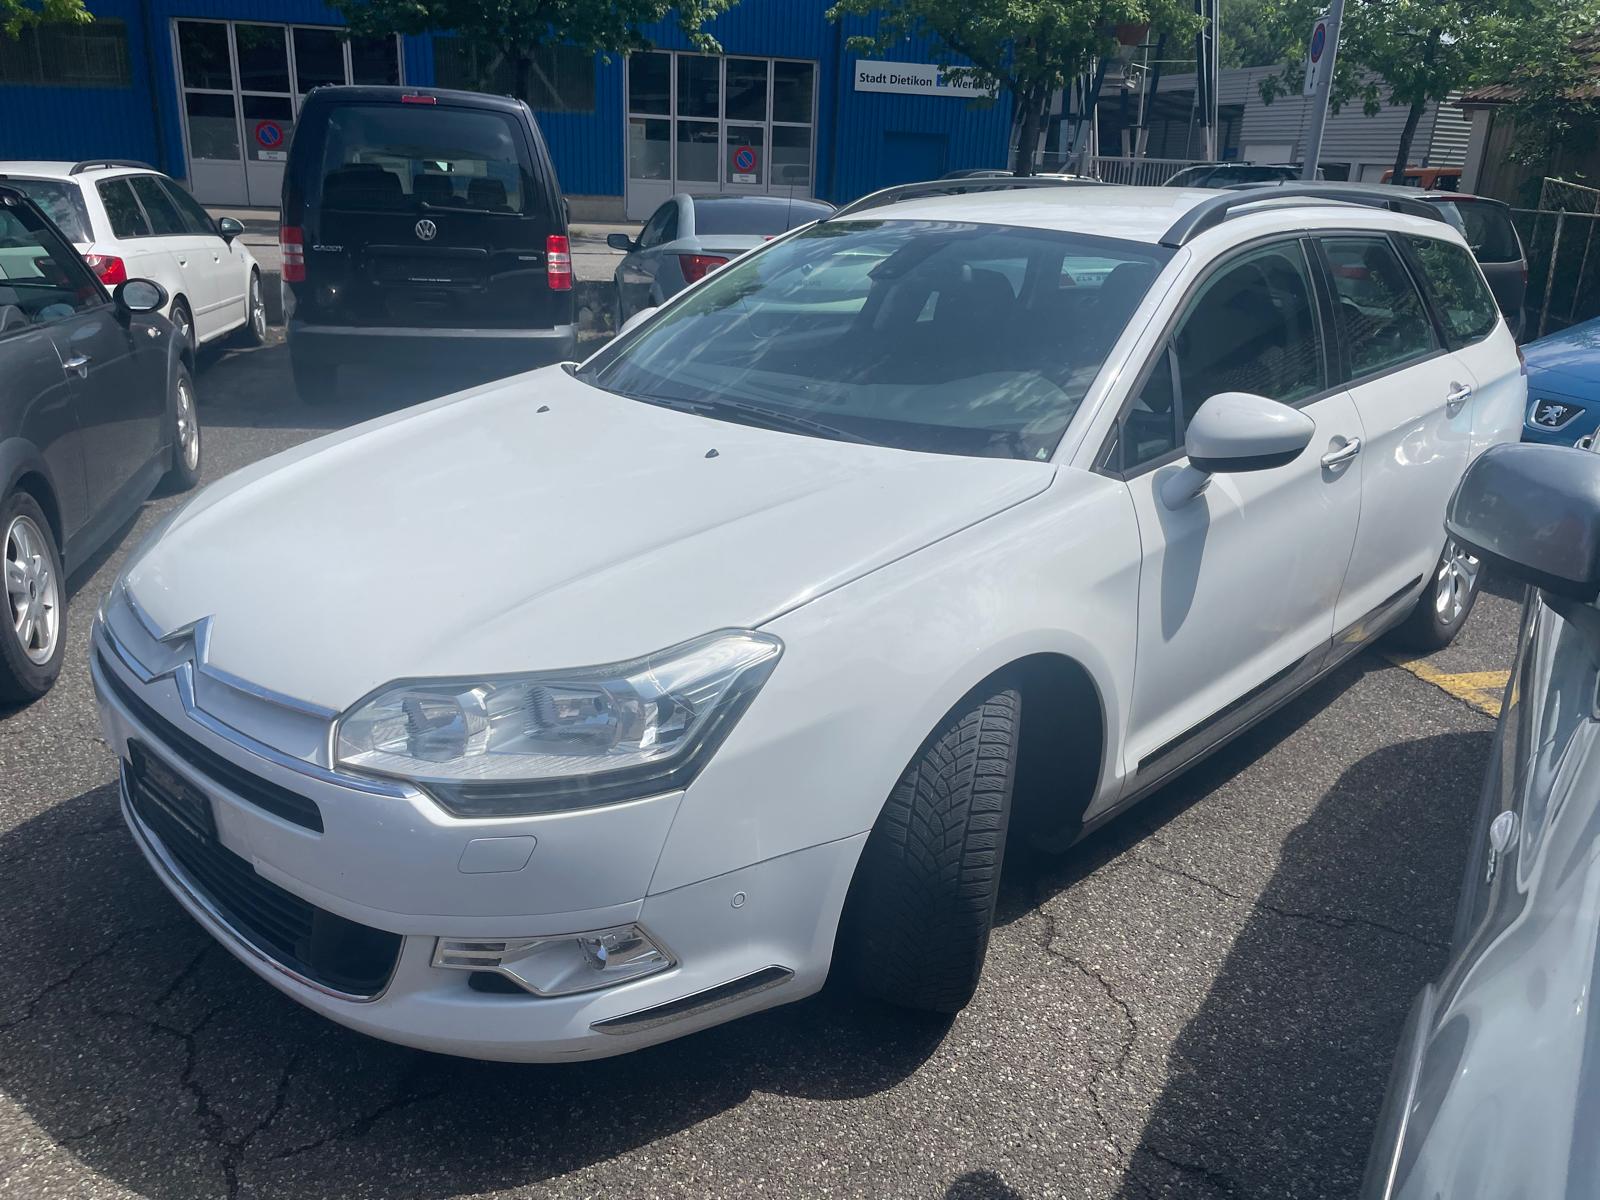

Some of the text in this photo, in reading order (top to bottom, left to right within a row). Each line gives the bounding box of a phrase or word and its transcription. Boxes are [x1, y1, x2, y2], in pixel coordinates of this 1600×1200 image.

[859, 72, 933, 87] Stadt Dietikon
[952, 76, 995, 91] Wero
